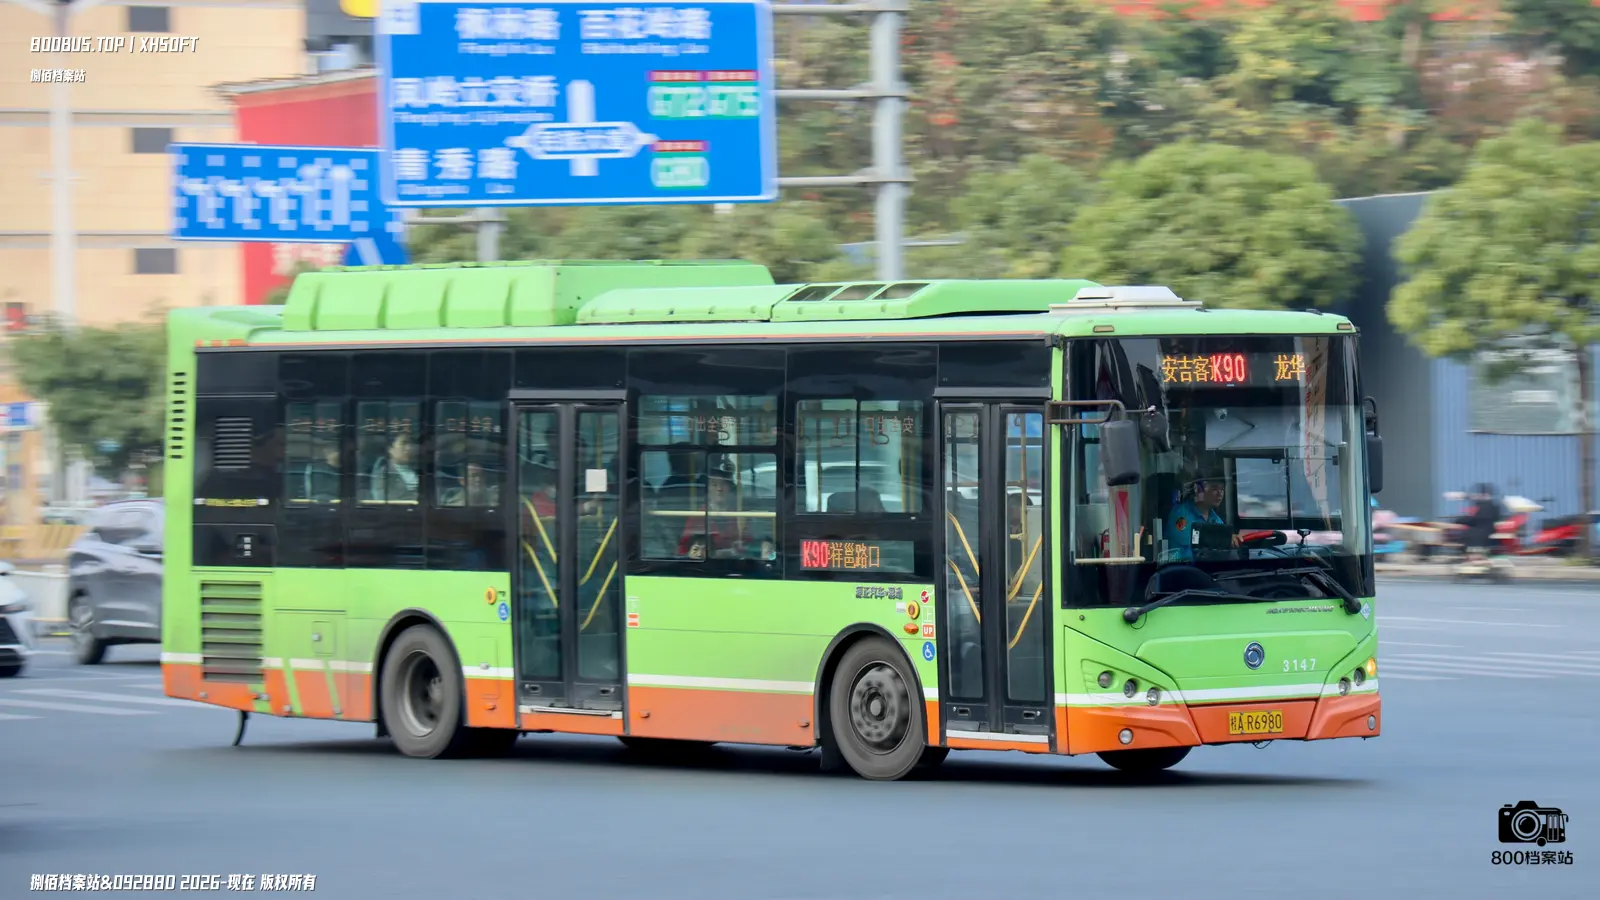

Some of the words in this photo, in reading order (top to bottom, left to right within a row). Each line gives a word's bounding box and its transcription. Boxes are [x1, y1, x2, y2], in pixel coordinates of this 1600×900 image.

[1212, 353, 1246, 383] K90
[1273, 354, 1307, 382] 龙华
[802, 541, 829, 569] K90
[923, 626, 933, 635] UP
[1283, 658, 1317, 673] 3147
